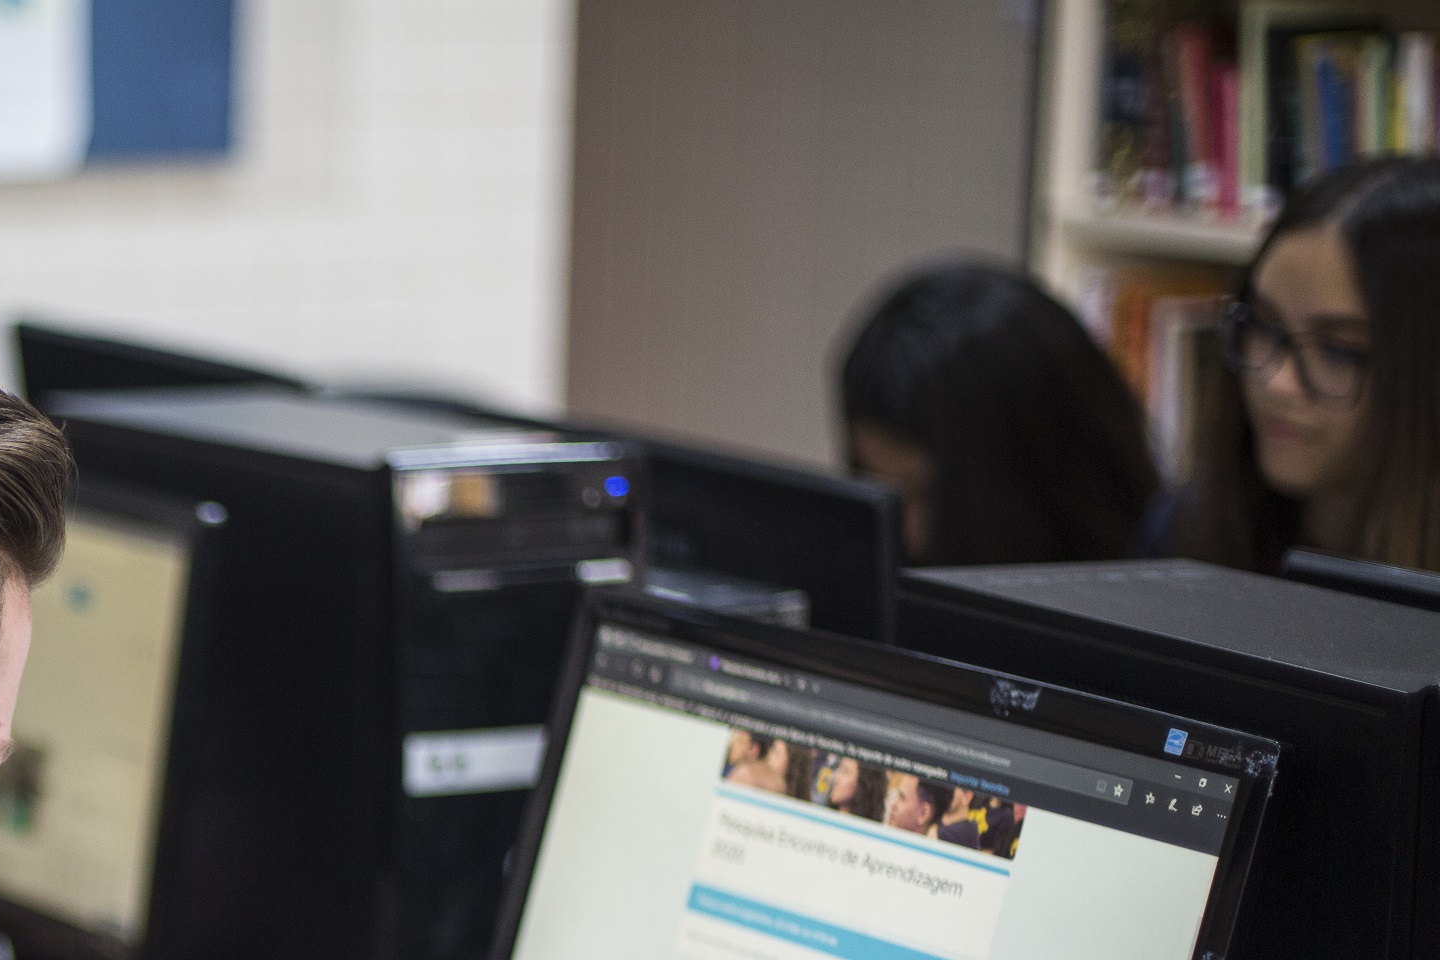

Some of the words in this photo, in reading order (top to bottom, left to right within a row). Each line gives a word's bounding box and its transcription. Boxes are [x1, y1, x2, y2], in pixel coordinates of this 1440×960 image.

[779, 829, 839, 859] Encontro
[840, 843, 858, 865] de
[859, 852, 964, 898] Aprendizagem
